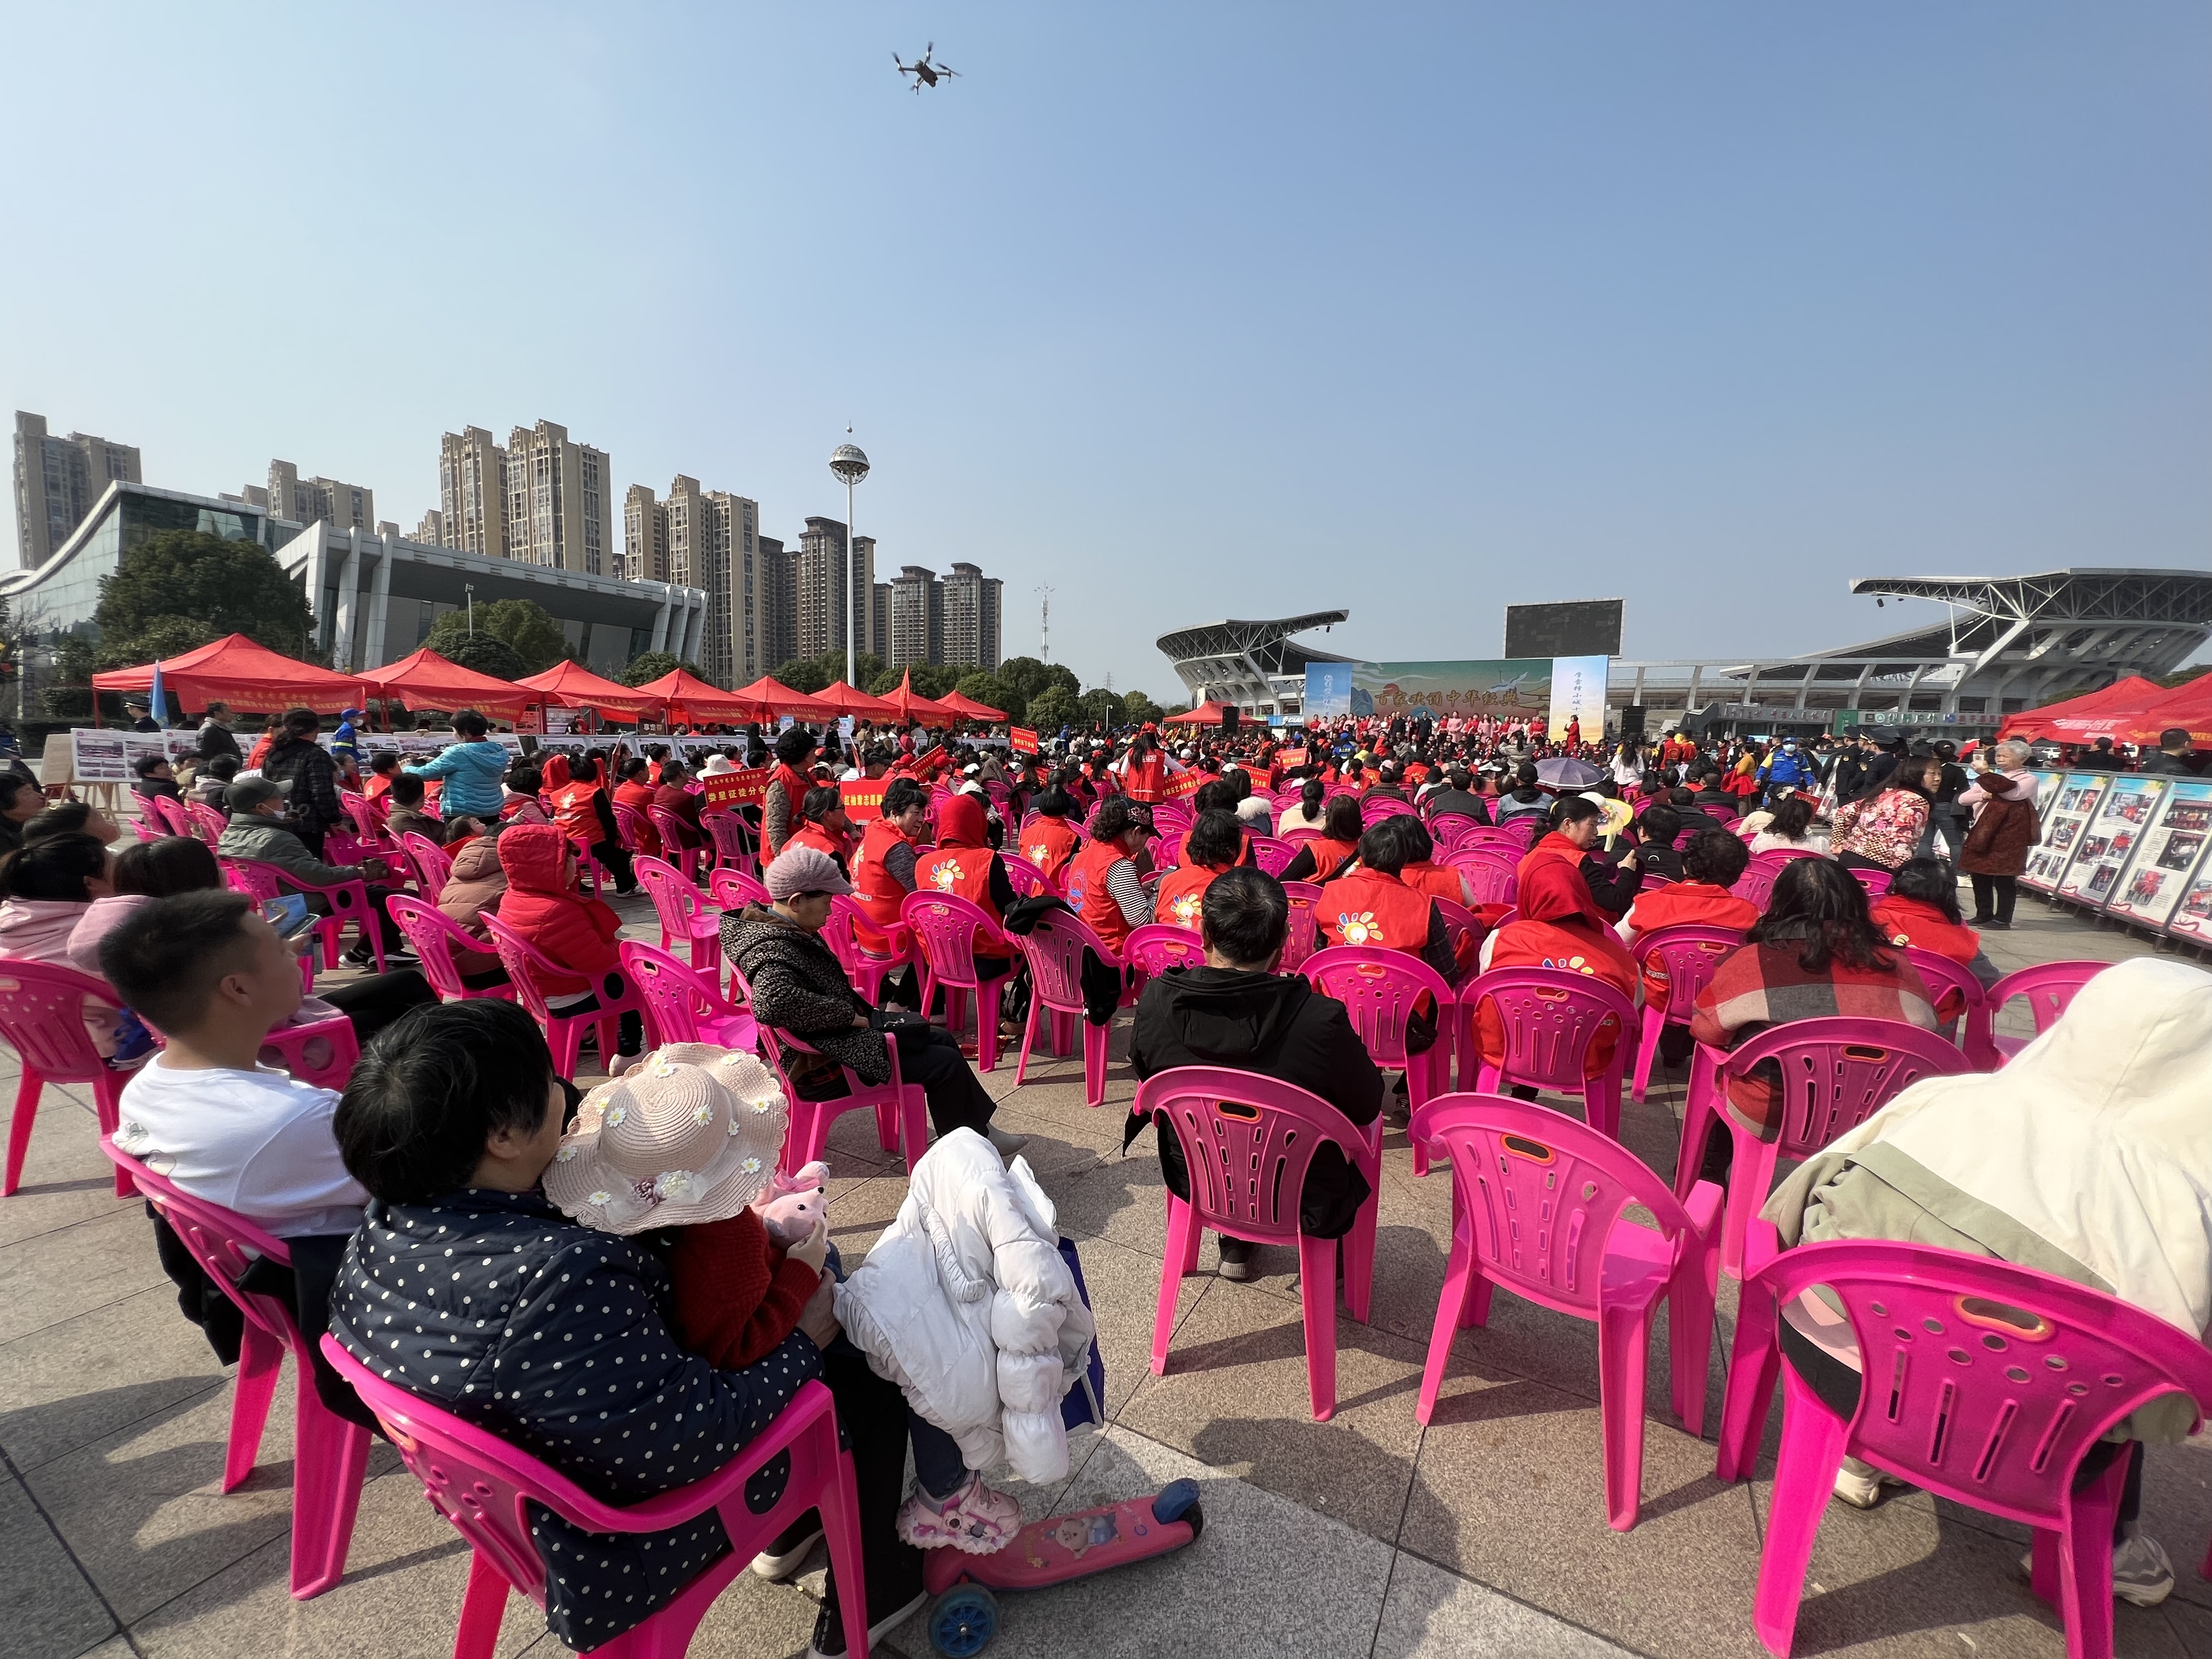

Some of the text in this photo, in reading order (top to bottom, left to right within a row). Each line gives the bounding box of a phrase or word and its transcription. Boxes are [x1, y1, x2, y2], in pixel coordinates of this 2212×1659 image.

[1375, 690, 1519, 707] 百家欢诵中华经典
